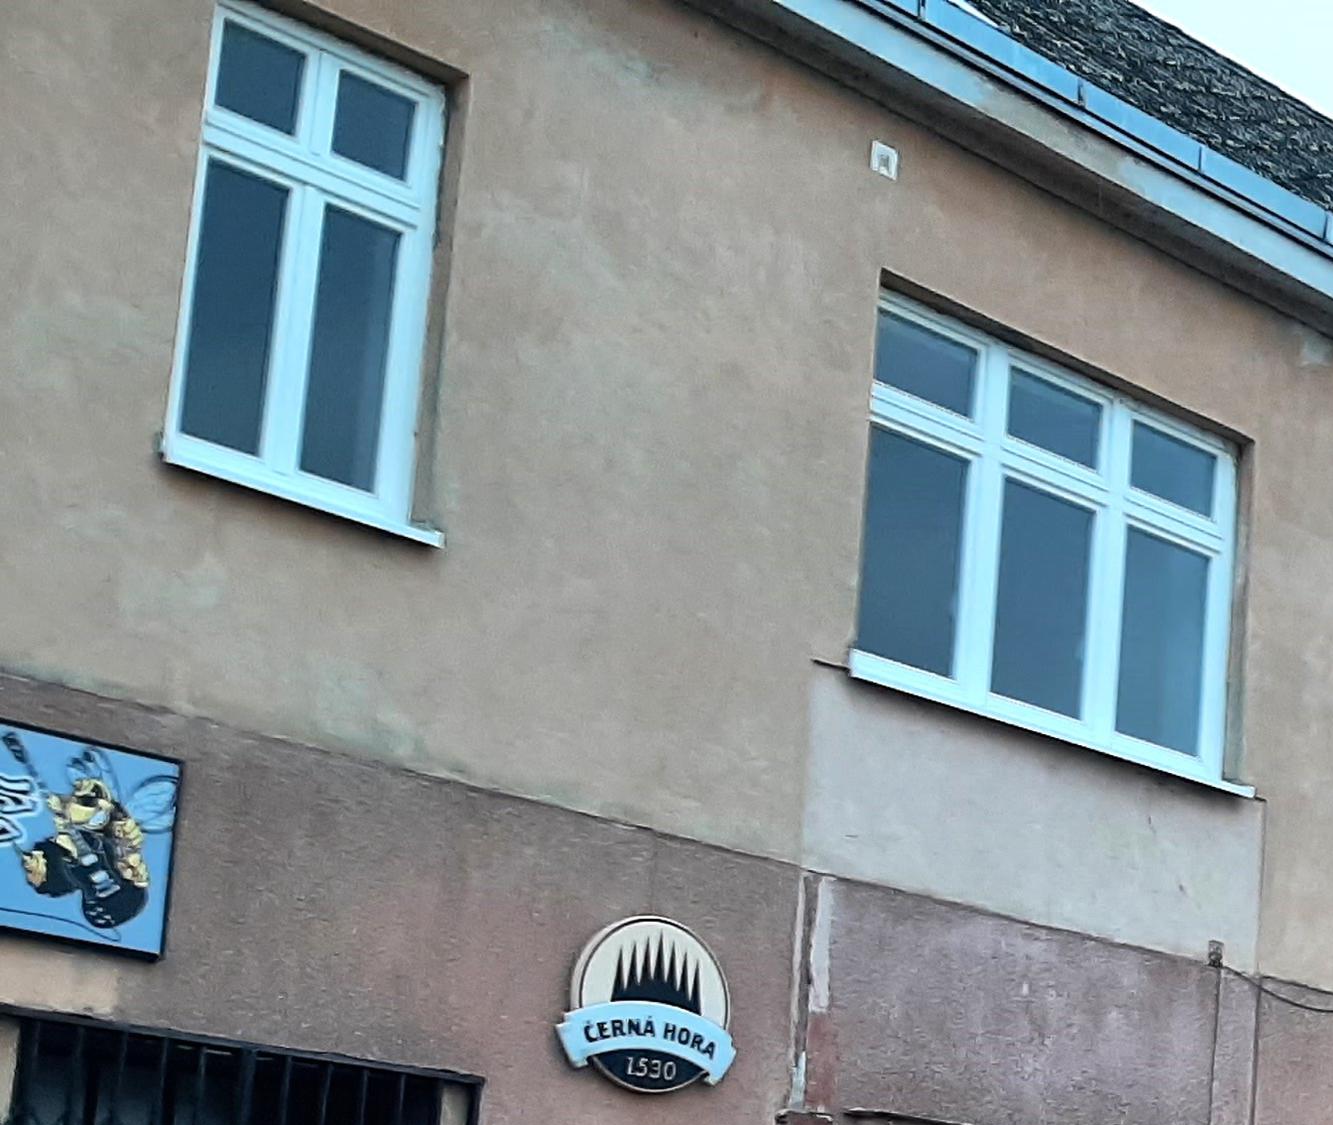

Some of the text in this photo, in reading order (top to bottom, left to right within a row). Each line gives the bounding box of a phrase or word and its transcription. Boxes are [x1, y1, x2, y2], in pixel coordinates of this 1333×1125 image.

[584, 1016, 717, 1061] ČERNÁ HORA
[625, 1055, 677, 1081] 1530
